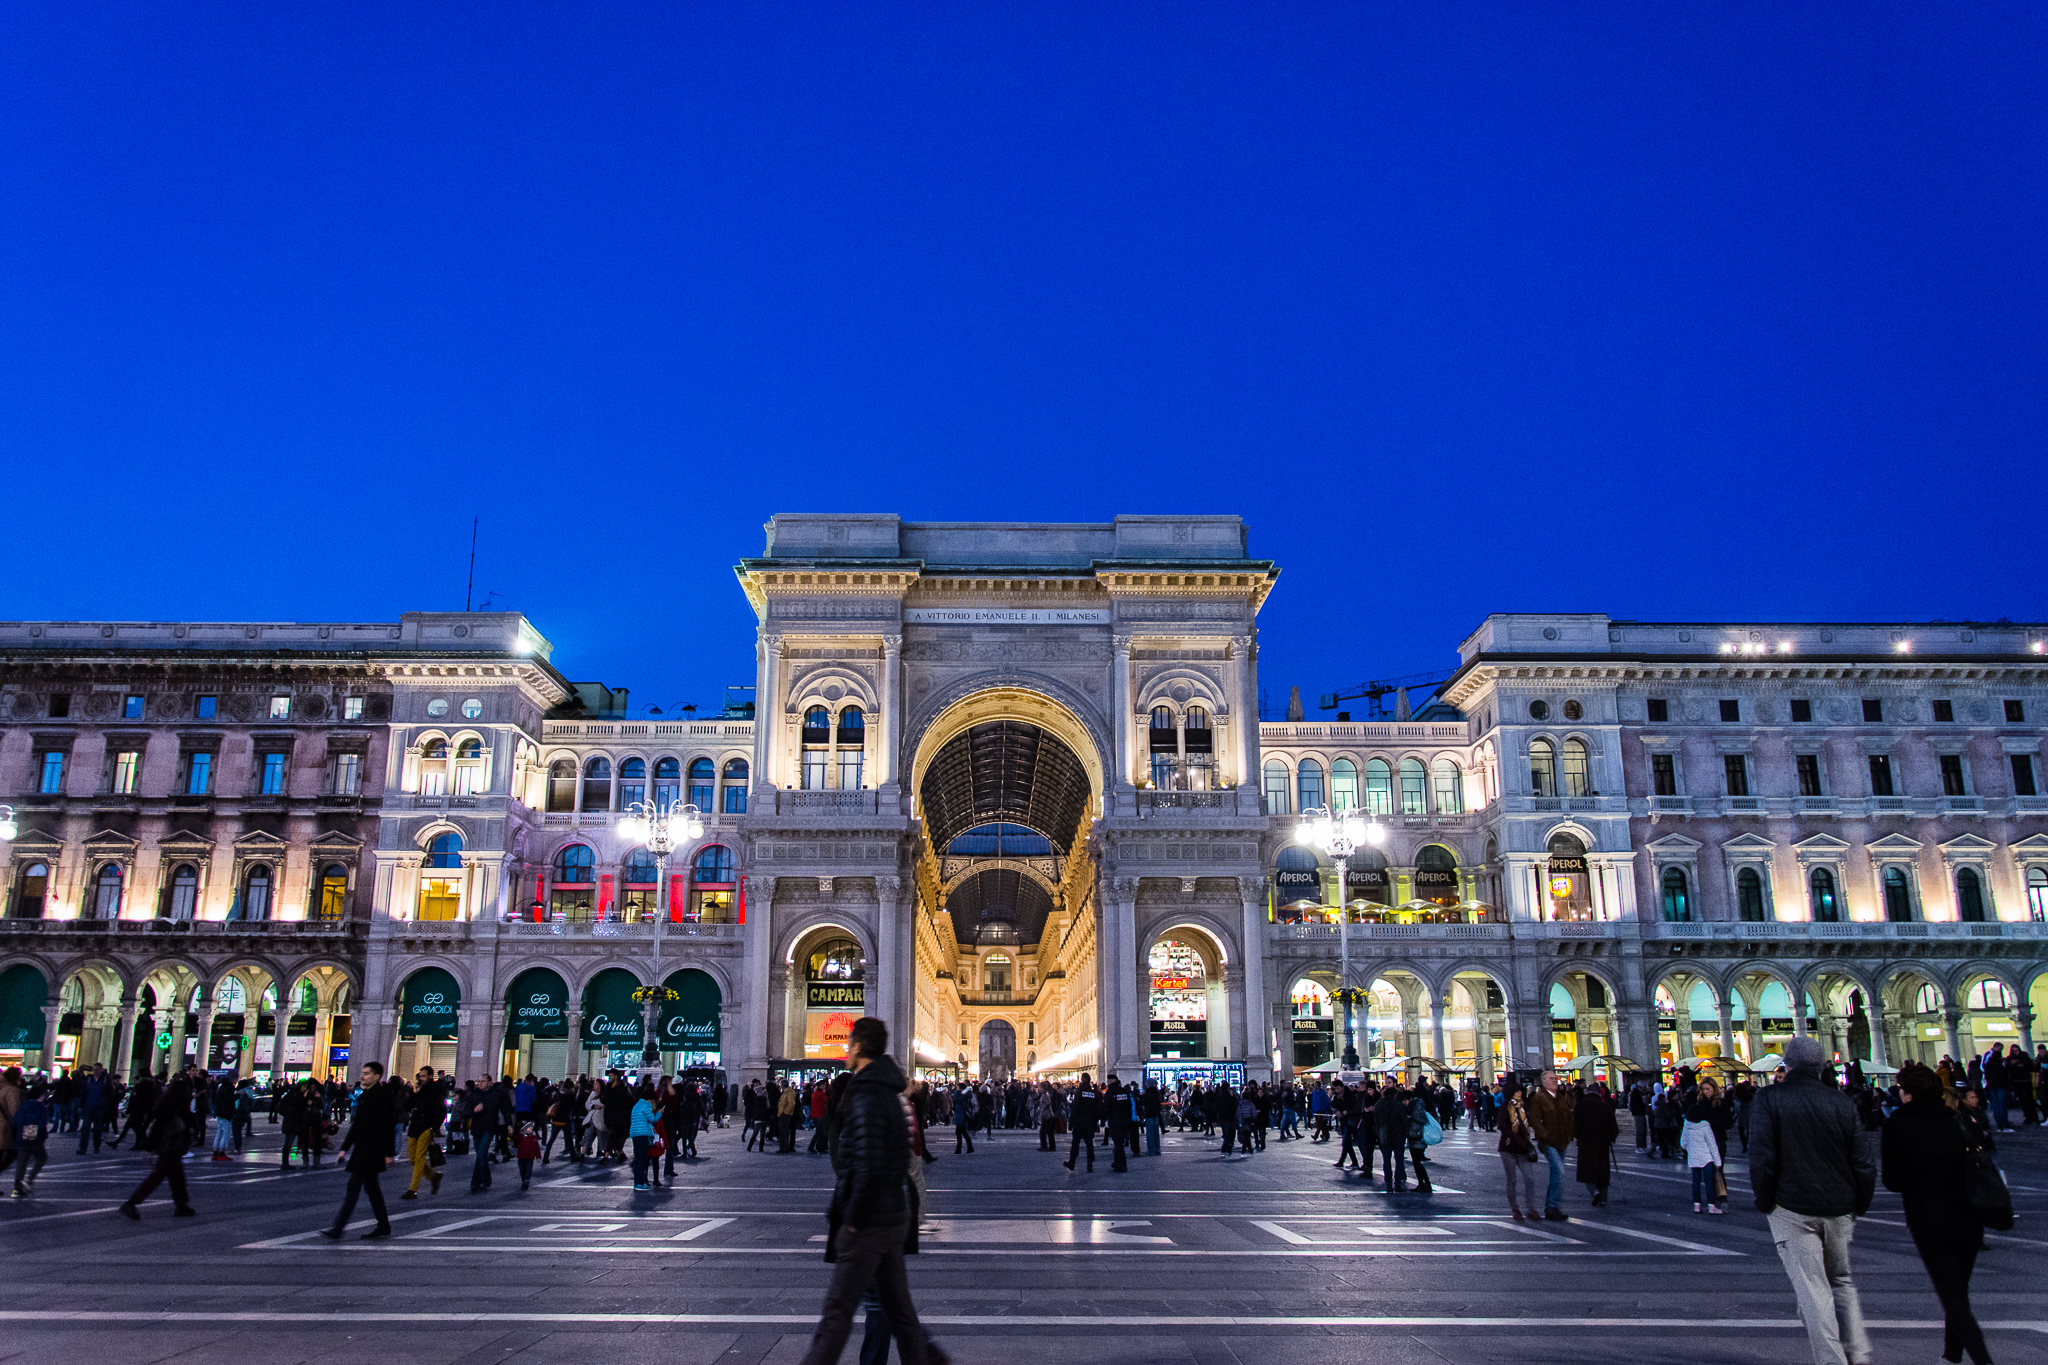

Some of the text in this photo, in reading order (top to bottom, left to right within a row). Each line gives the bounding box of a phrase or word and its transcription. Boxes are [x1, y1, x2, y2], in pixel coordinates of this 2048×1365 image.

[915, 612, 921, 620] A
[927, 612, 971, 620] VITTORIO
[975, 612, 1027, 620] EMANUELE
[1549, 857, 1583, 869] APEROL
[1280, 871, 1314, 883] APEROL
[1348, 871, 1382, 882] APEROL
[1417, 871, 1451, 882] APEROL
[1155, 978, 1188, 988] Kartell
[412, 1005, 453, 1014] GRIMOLDI
[518, 1007, 560, 1017] GRIMOLDI
[590, 1014, 638, 1035] Currado
[667, 1015, 715, 1037] Currado
[1163, 1021, 1187, 1030] Motta
[1294, 1020, 1317, 1029] Motta
